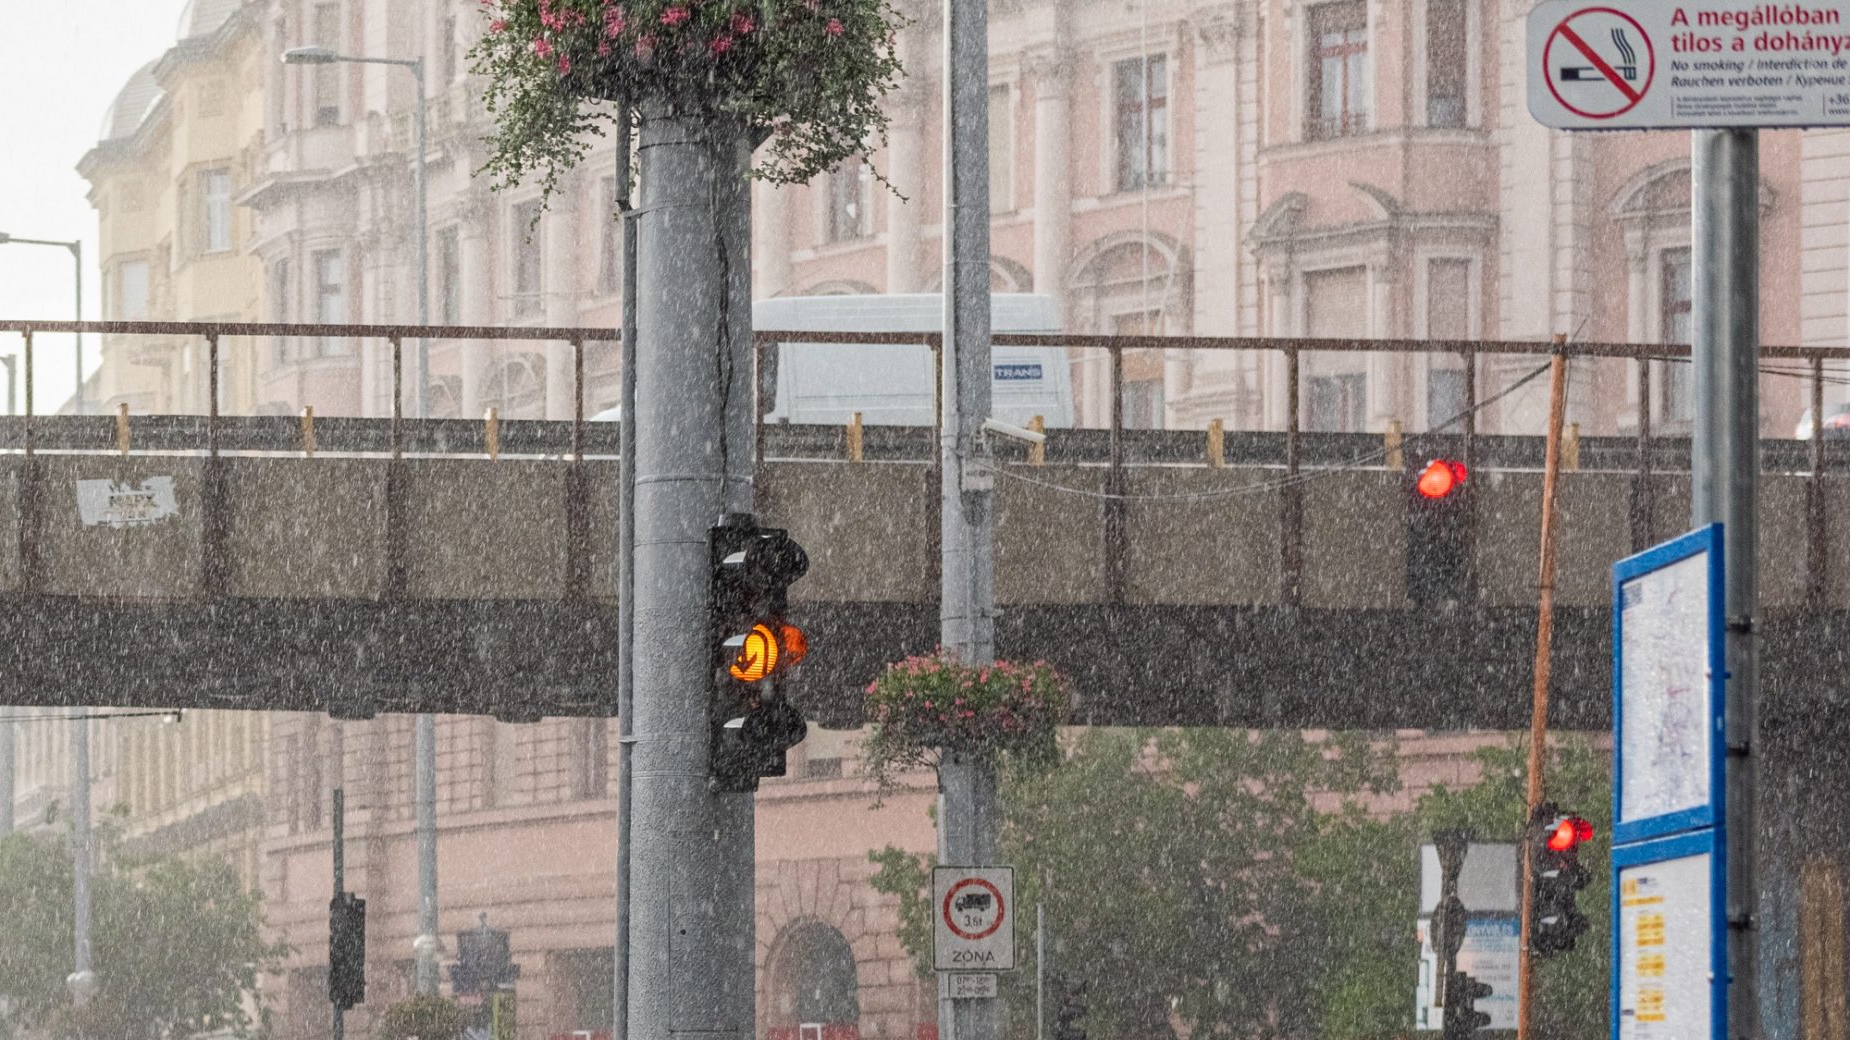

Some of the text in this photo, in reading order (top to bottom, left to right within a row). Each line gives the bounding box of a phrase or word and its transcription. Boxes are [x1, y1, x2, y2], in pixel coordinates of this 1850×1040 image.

[1671, 5, 1840, 31] A megállóban
[1671, 32, 1722, 53] tilos
[1731, 37, 1745, 52] a
[1671, 60, 1689, 71] No
[1693, 59, 1745, 73] smoking
[1757, 58, 1828, 71] Interdiction
[1832, 59, 1847, 70] de
[1671, 76, 1724, 88] Rauchen
[1728, 75, 1783, 87] verboten
[996, 367, 1040, 377] TRANS
[952, 950, 996, 962] ZÓNA
